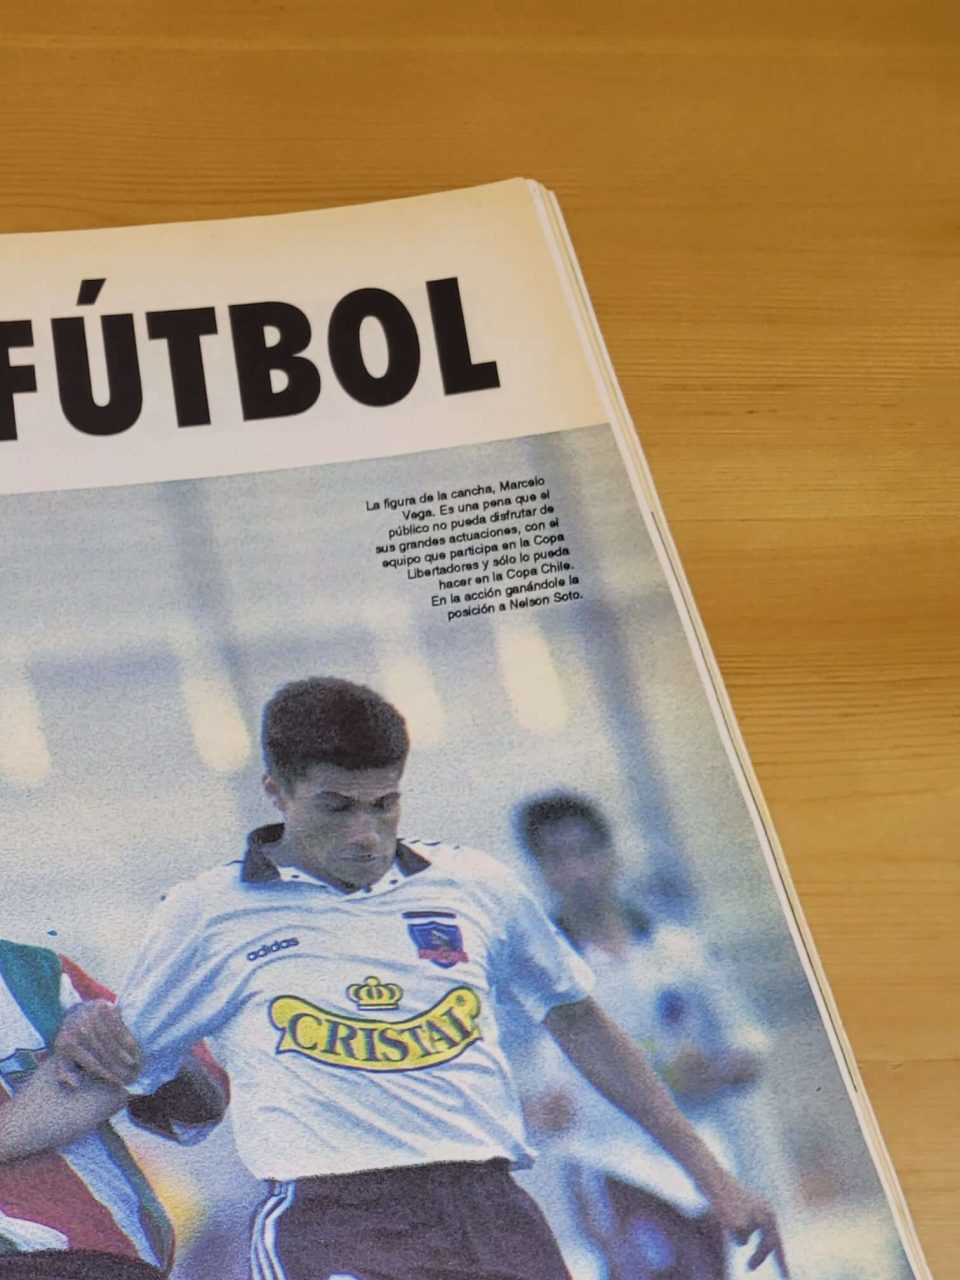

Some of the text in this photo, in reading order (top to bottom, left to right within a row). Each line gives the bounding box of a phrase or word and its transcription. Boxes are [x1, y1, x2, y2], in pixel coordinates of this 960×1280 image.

[366, 476, 545, 511] La figura de la cancha, Marcelo
[402, 489, 550, 522] Vega. Es una pena que el
[376, 517, 559, 554] sus grandes actuaciones, con el
[389, 504, 554, 540] público no pueda disfrutar de
[382, 534, 565, 569] equipo que participa en la Copa
[407, 546, 570, 579] Libertadores y sólo lo pueda
[431, 575, 579, 607] En la acción ganándole la
[439, 561, 574, 590] hacer en la Copa Chile.
[448, 591, 583, 622] posición a Nelson Soto.
